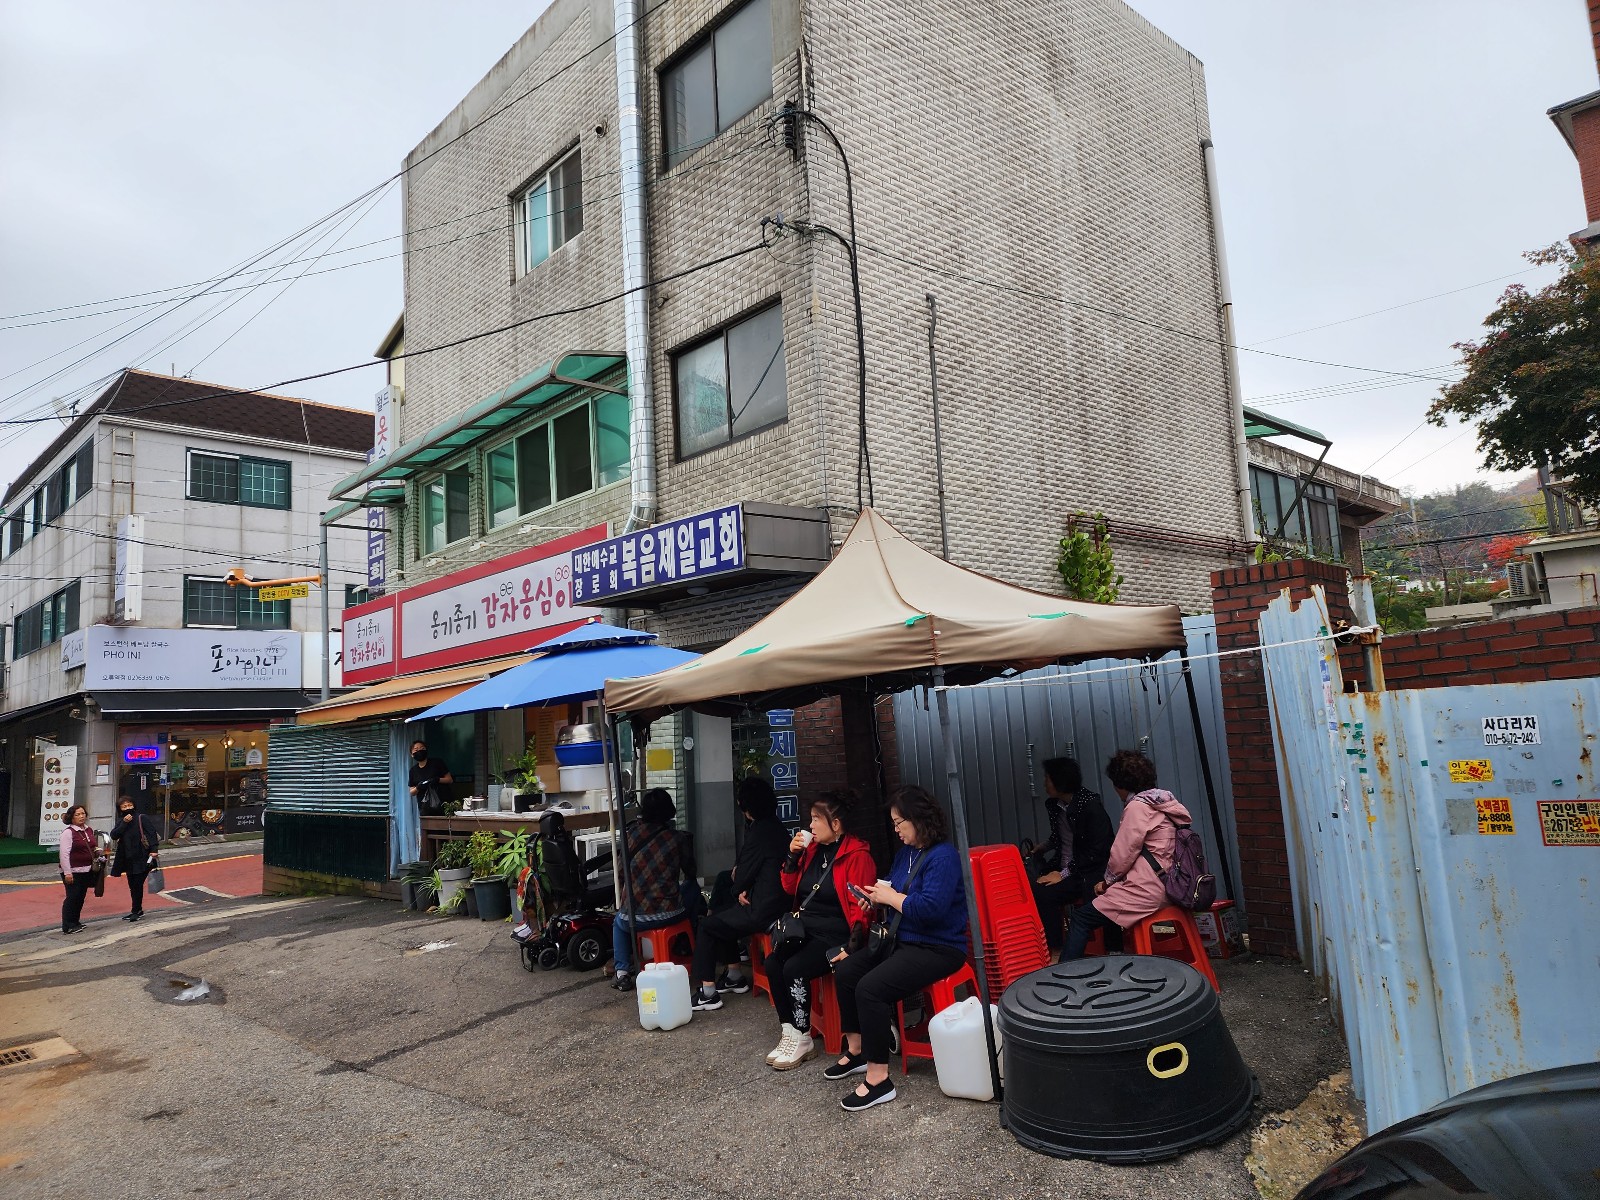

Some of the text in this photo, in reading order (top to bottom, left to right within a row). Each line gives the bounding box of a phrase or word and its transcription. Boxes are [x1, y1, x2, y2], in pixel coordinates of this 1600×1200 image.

[574, 510, 740, 587] 대한예수교 복음제일교회
[277, 589, 290, 598] CCTV
[430, 576, 573, 640] 옹기종기 감자옹심이
[356, 618, 380, 639] 옹기종기
[103, 650, 125, 659] PHO
[349, 640, 385, 665] 감자옹심이
[127, 749, 157, 760] OPEN
[1477, 799, 1510, 813] 소액결제
